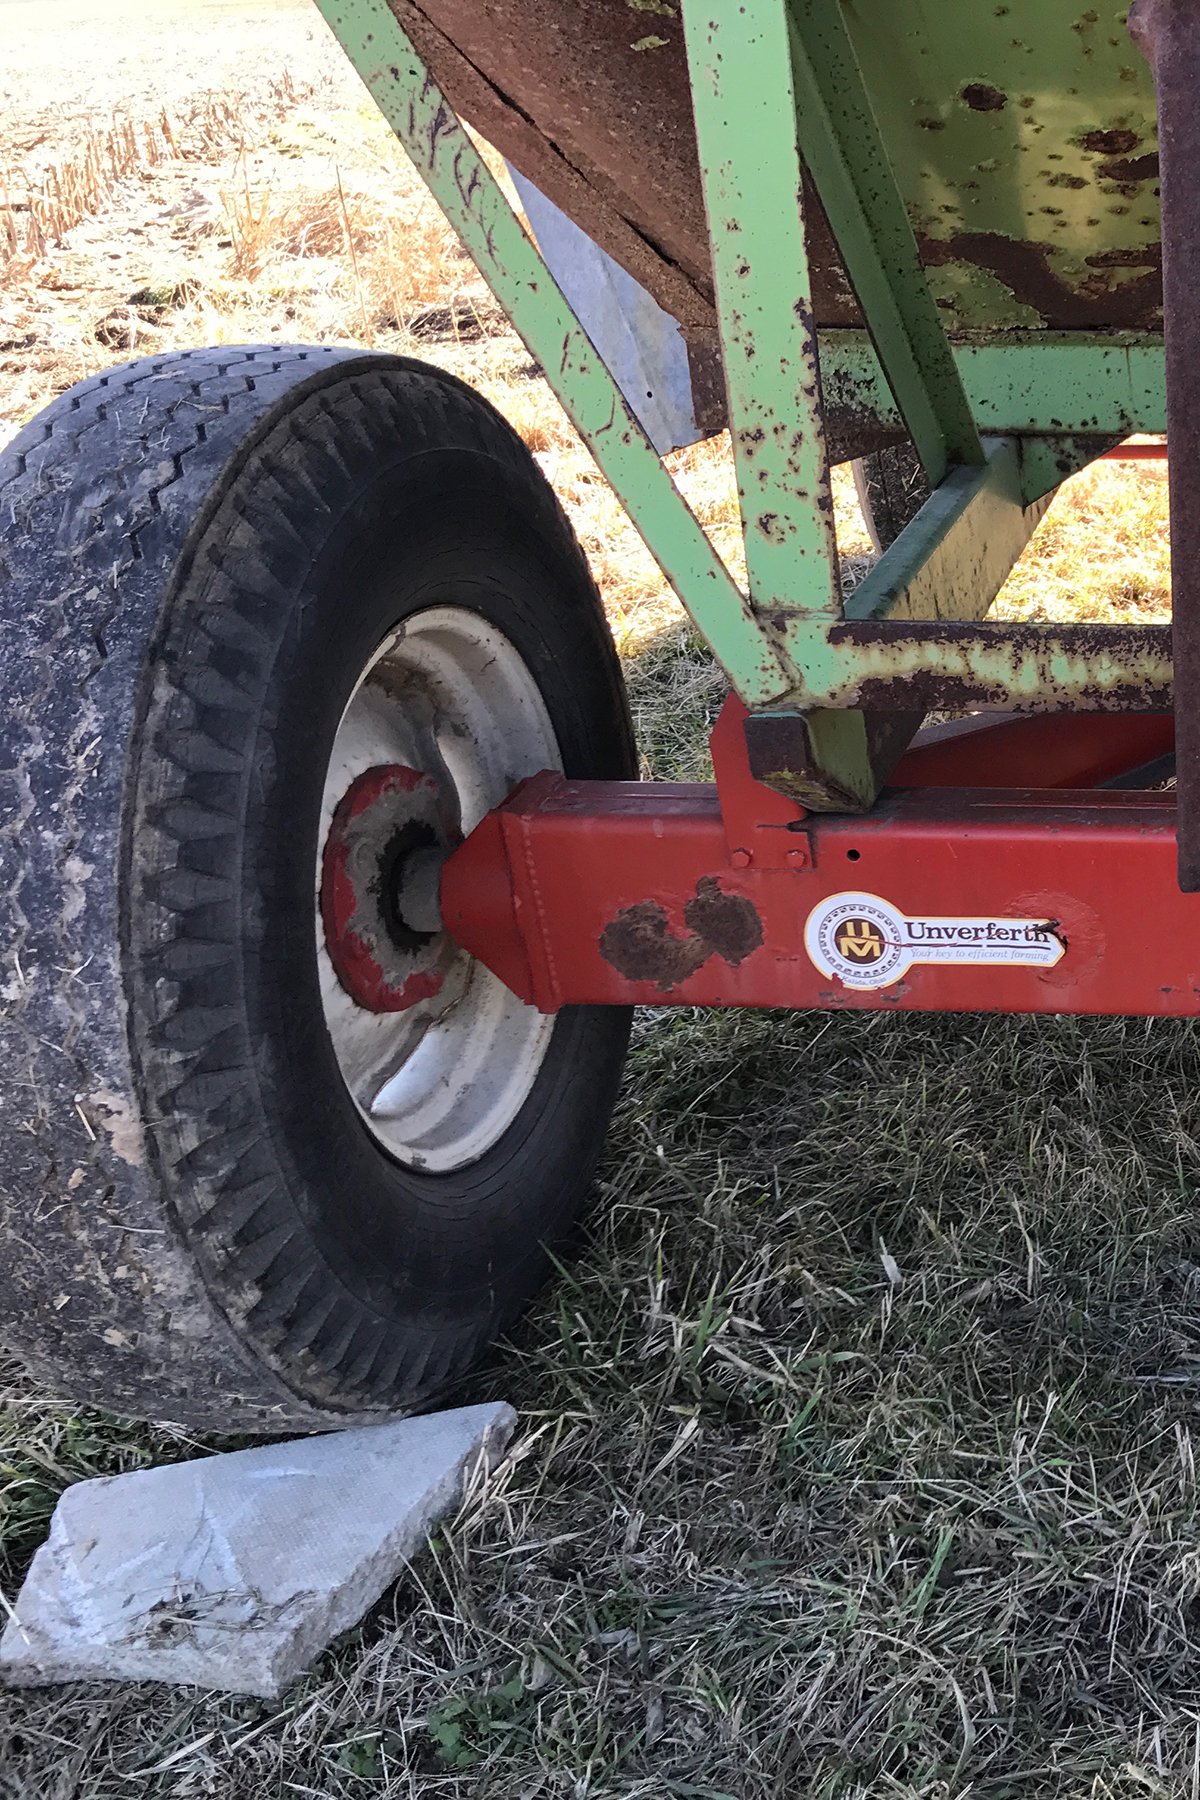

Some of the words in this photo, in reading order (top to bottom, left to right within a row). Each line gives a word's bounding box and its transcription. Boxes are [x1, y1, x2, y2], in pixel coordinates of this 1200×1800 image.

[904, 921, 1051, 943] Unverferth
[911, 949, 931, 959] Your
[936, 949, 952, 961] key
[955, 949, 966, 958] to
[967, 949, 1008, 960] efficient
[1010, 950, 1049, 962] farming
